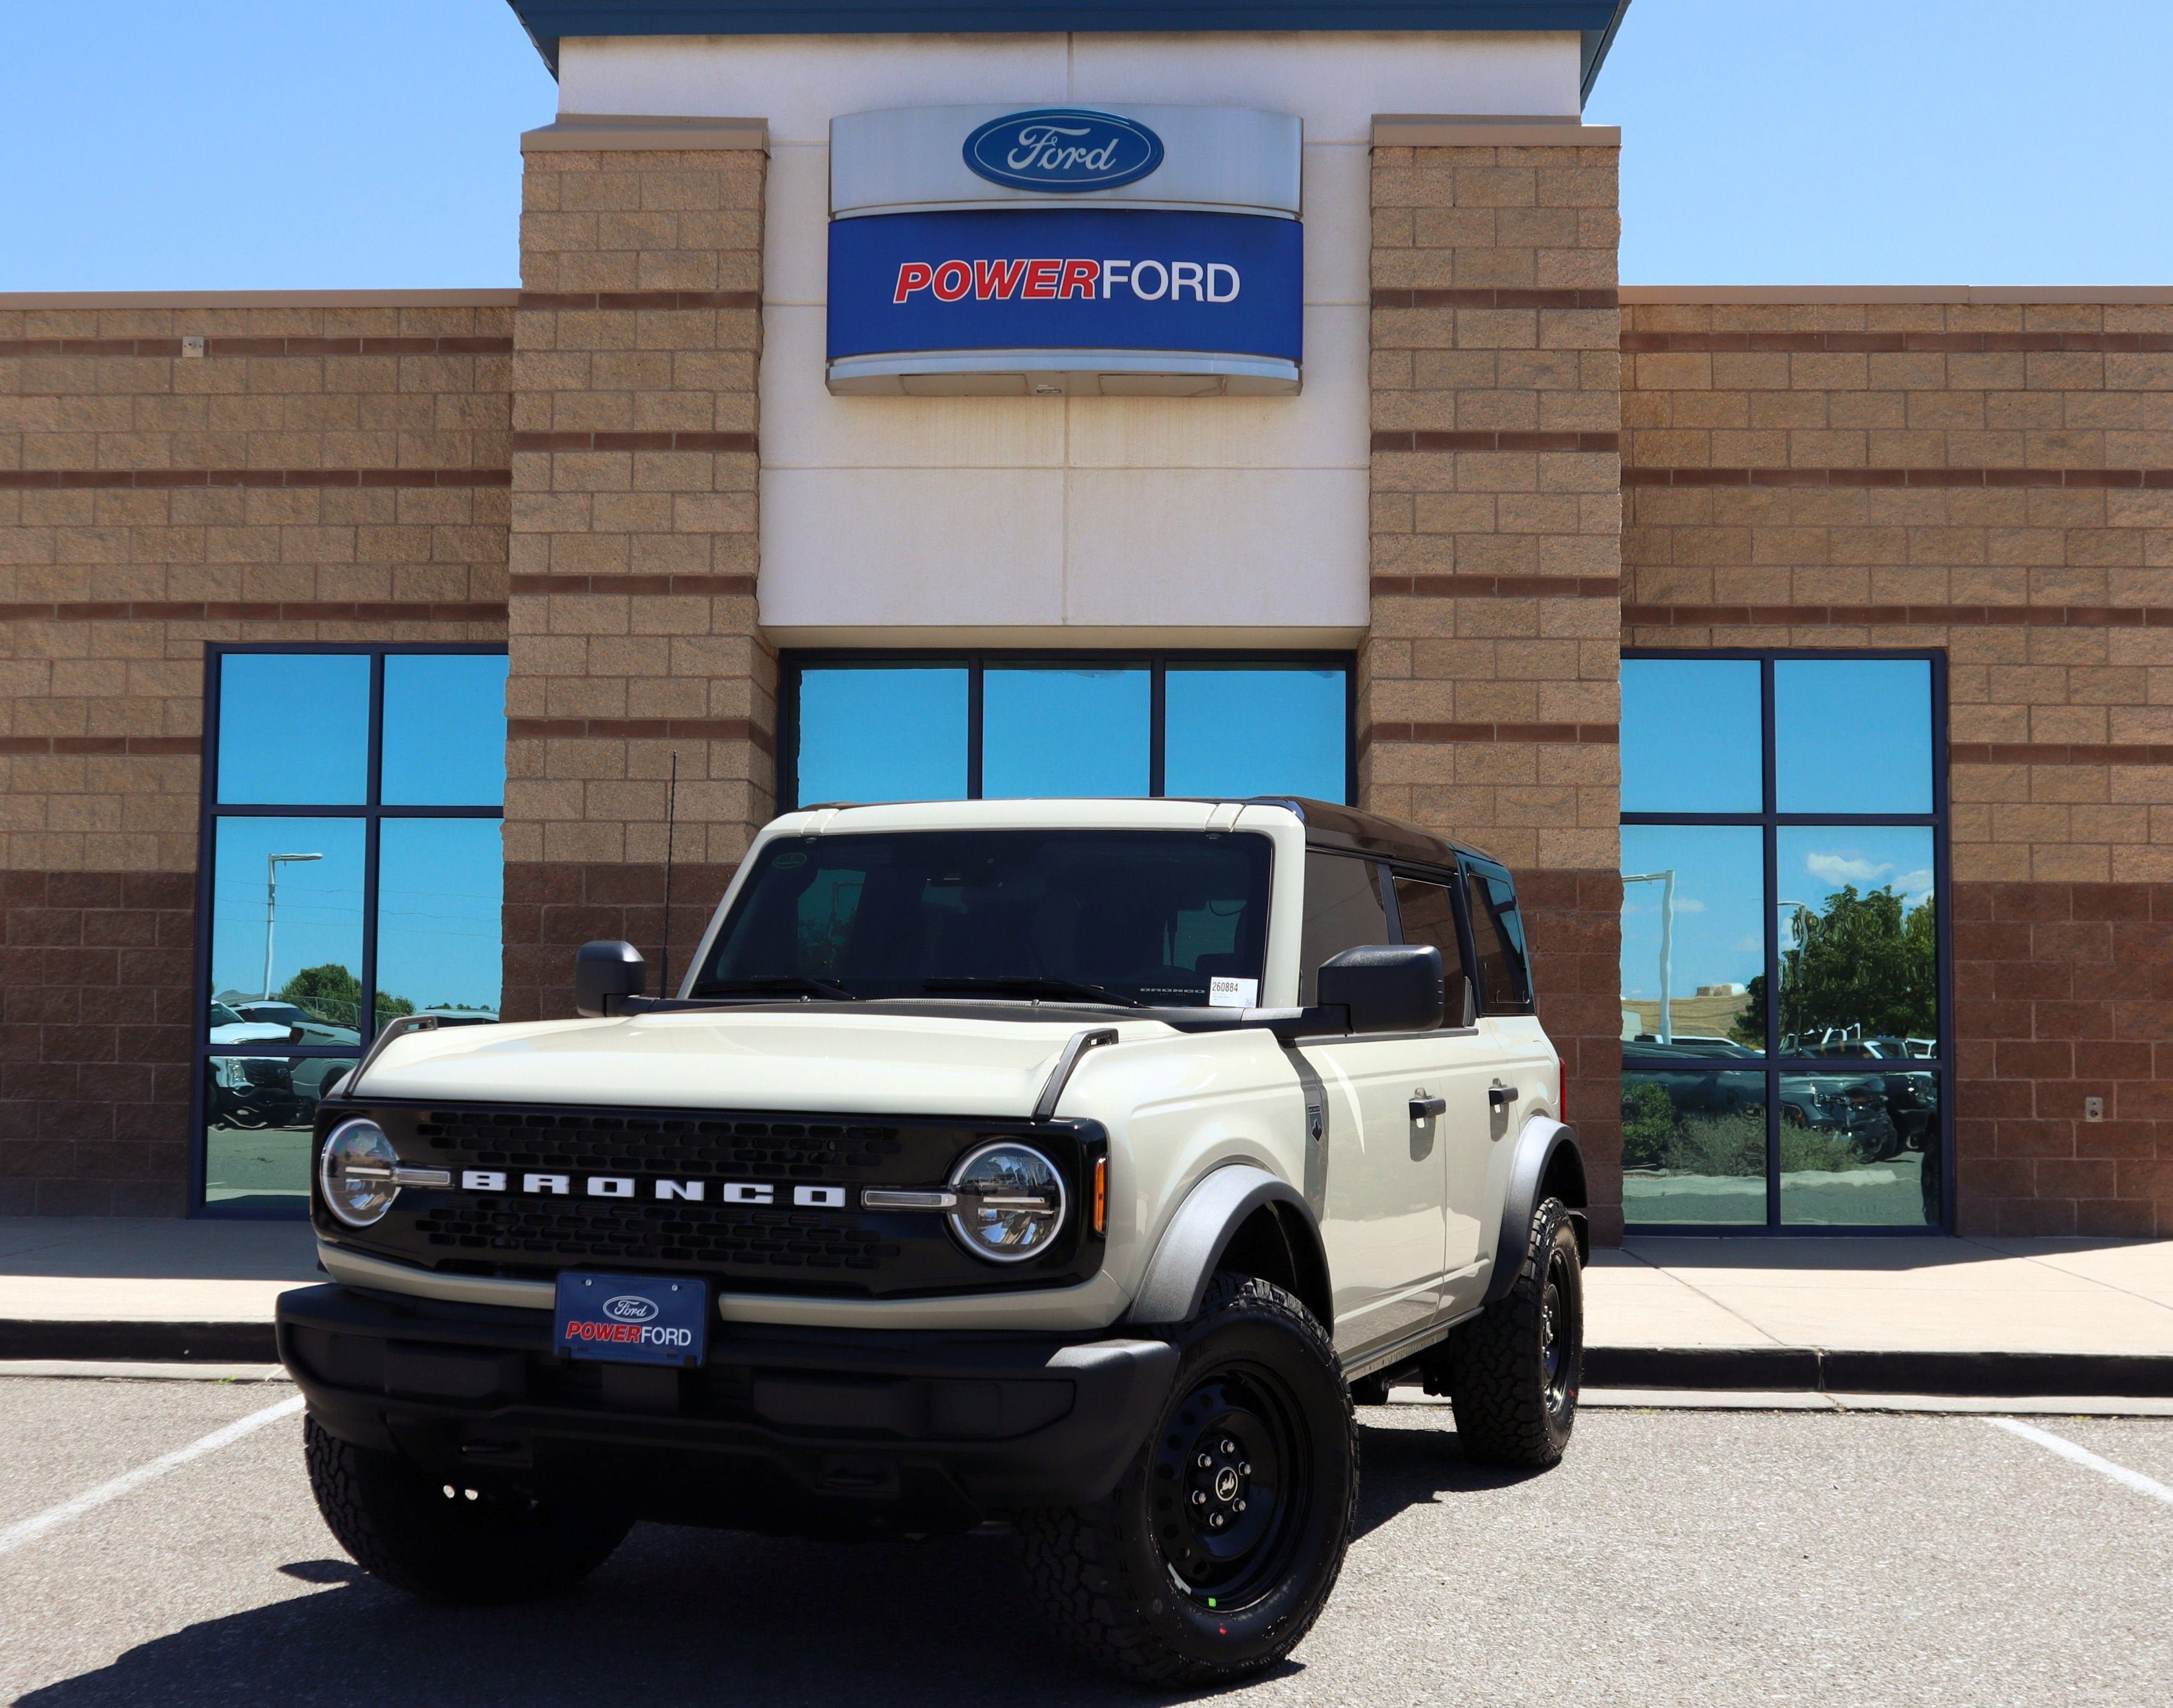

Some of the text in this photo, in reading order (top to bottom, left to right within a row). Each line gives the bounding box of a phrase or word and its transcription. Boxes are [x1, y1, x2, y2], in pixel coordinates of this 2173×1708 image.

[1007, 125, 1119, 171] Ford
[893, 259, 1240, 303] POWERFORD
[1212, 982, 1238, 992] 260884
[462, 1170, 845, 1207] BRONCO
[614, 1300, 648, 1317] Ford
[565, 1321, 692, 1346] POWERFORD
